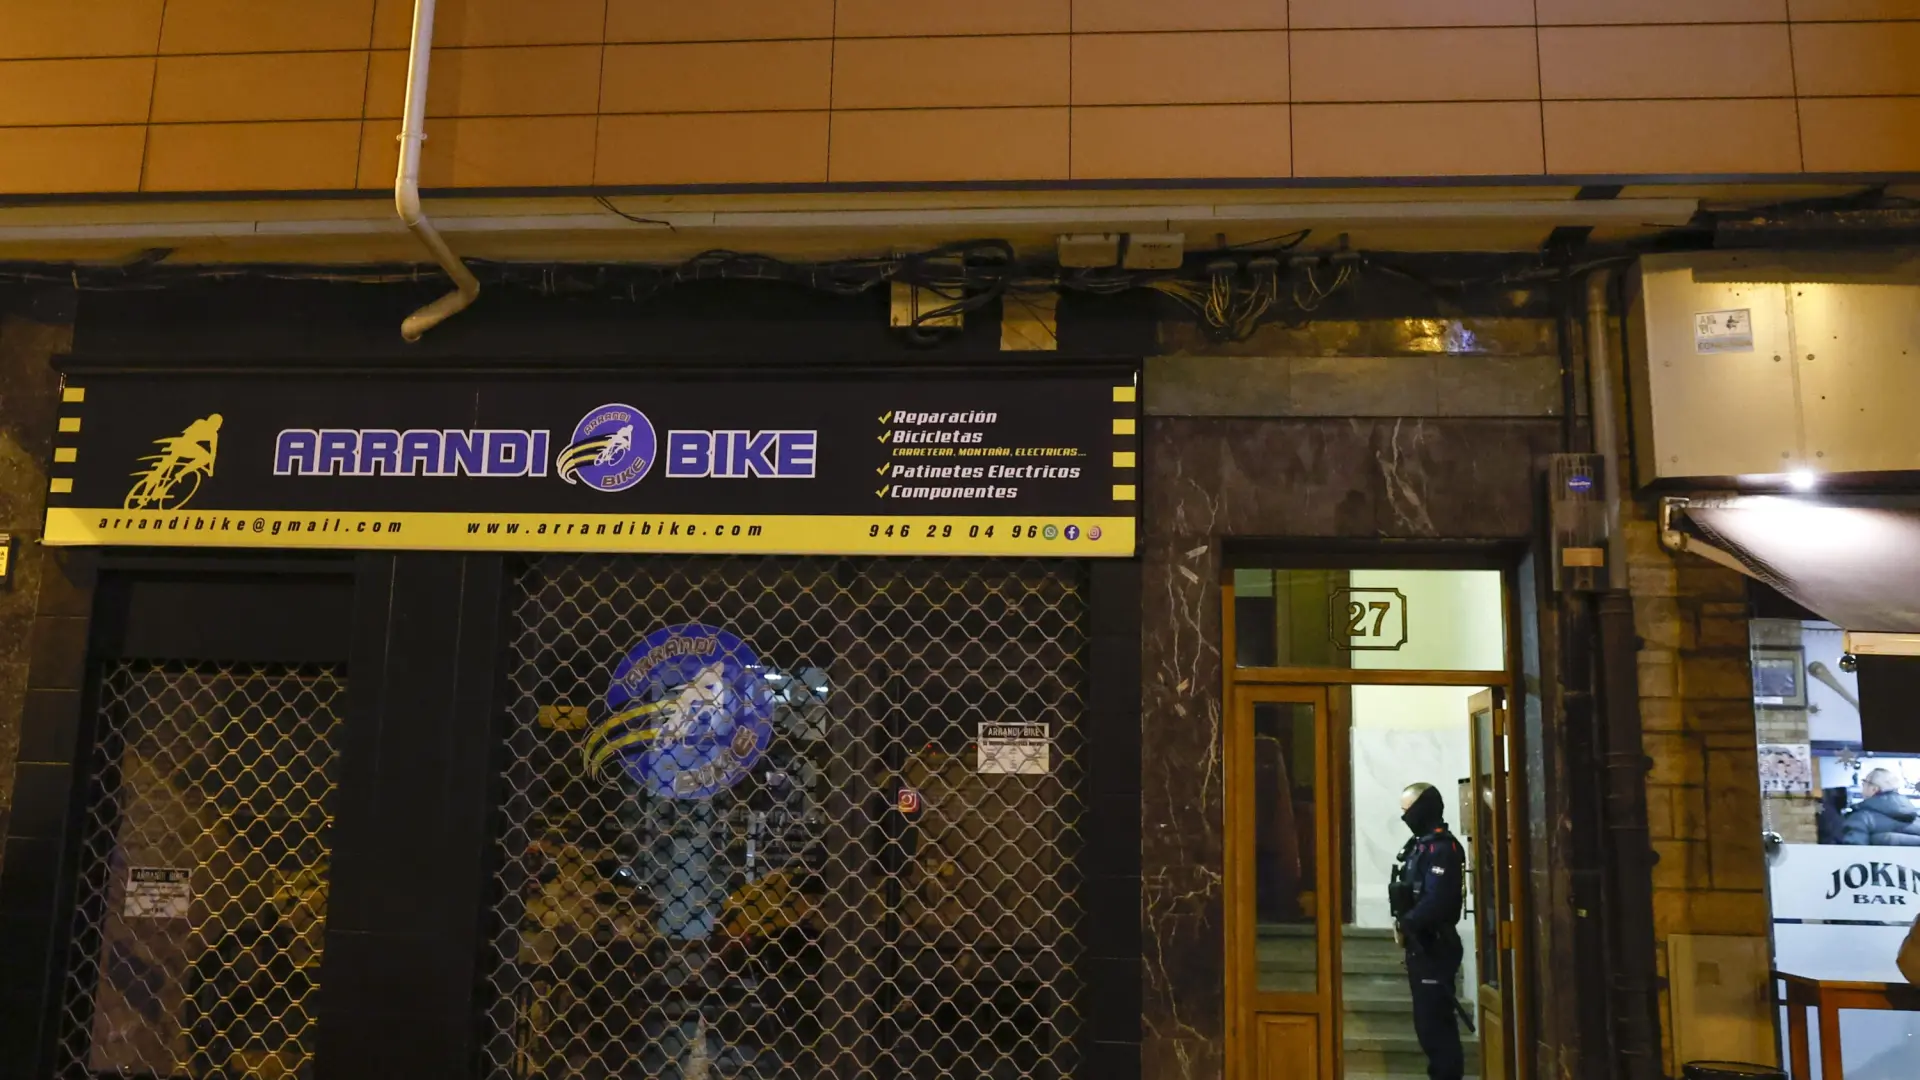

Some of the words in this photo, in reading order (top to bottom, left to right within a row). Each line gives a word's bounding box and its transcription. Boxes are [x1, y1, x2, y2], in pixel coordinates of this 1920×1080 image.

[583, 411, 632, 436] ARRANDI
[893, 410, 998, 426] Reparación
[892, 430, 983, 444] Bicicletas
[273, 428, 550, 477] ARRANDI
[665, 429, 818, 478] BIKE
[892, 447, 957, 457] CARRETERA,
[600, 456, 647, 488] BIKE
[891, 464, 984, 479] Patinetes
[987, 464, 1081, 479] Electricos
[890, 484, 1019, 500] Componentes
[99, 515, 403, 537] arrandibike@gmail.com
[466, 520, 763, 537] www.arrandibike.com
[869, 524, 911, 538] 946
[926, 524, 952, 538] 29
[969, 524, 994, 538] 04
[1011, 524, 1038, 538] 96
[1345, 601, 1390, 637] 27
[1853, 894, 1907, 905] BAR
